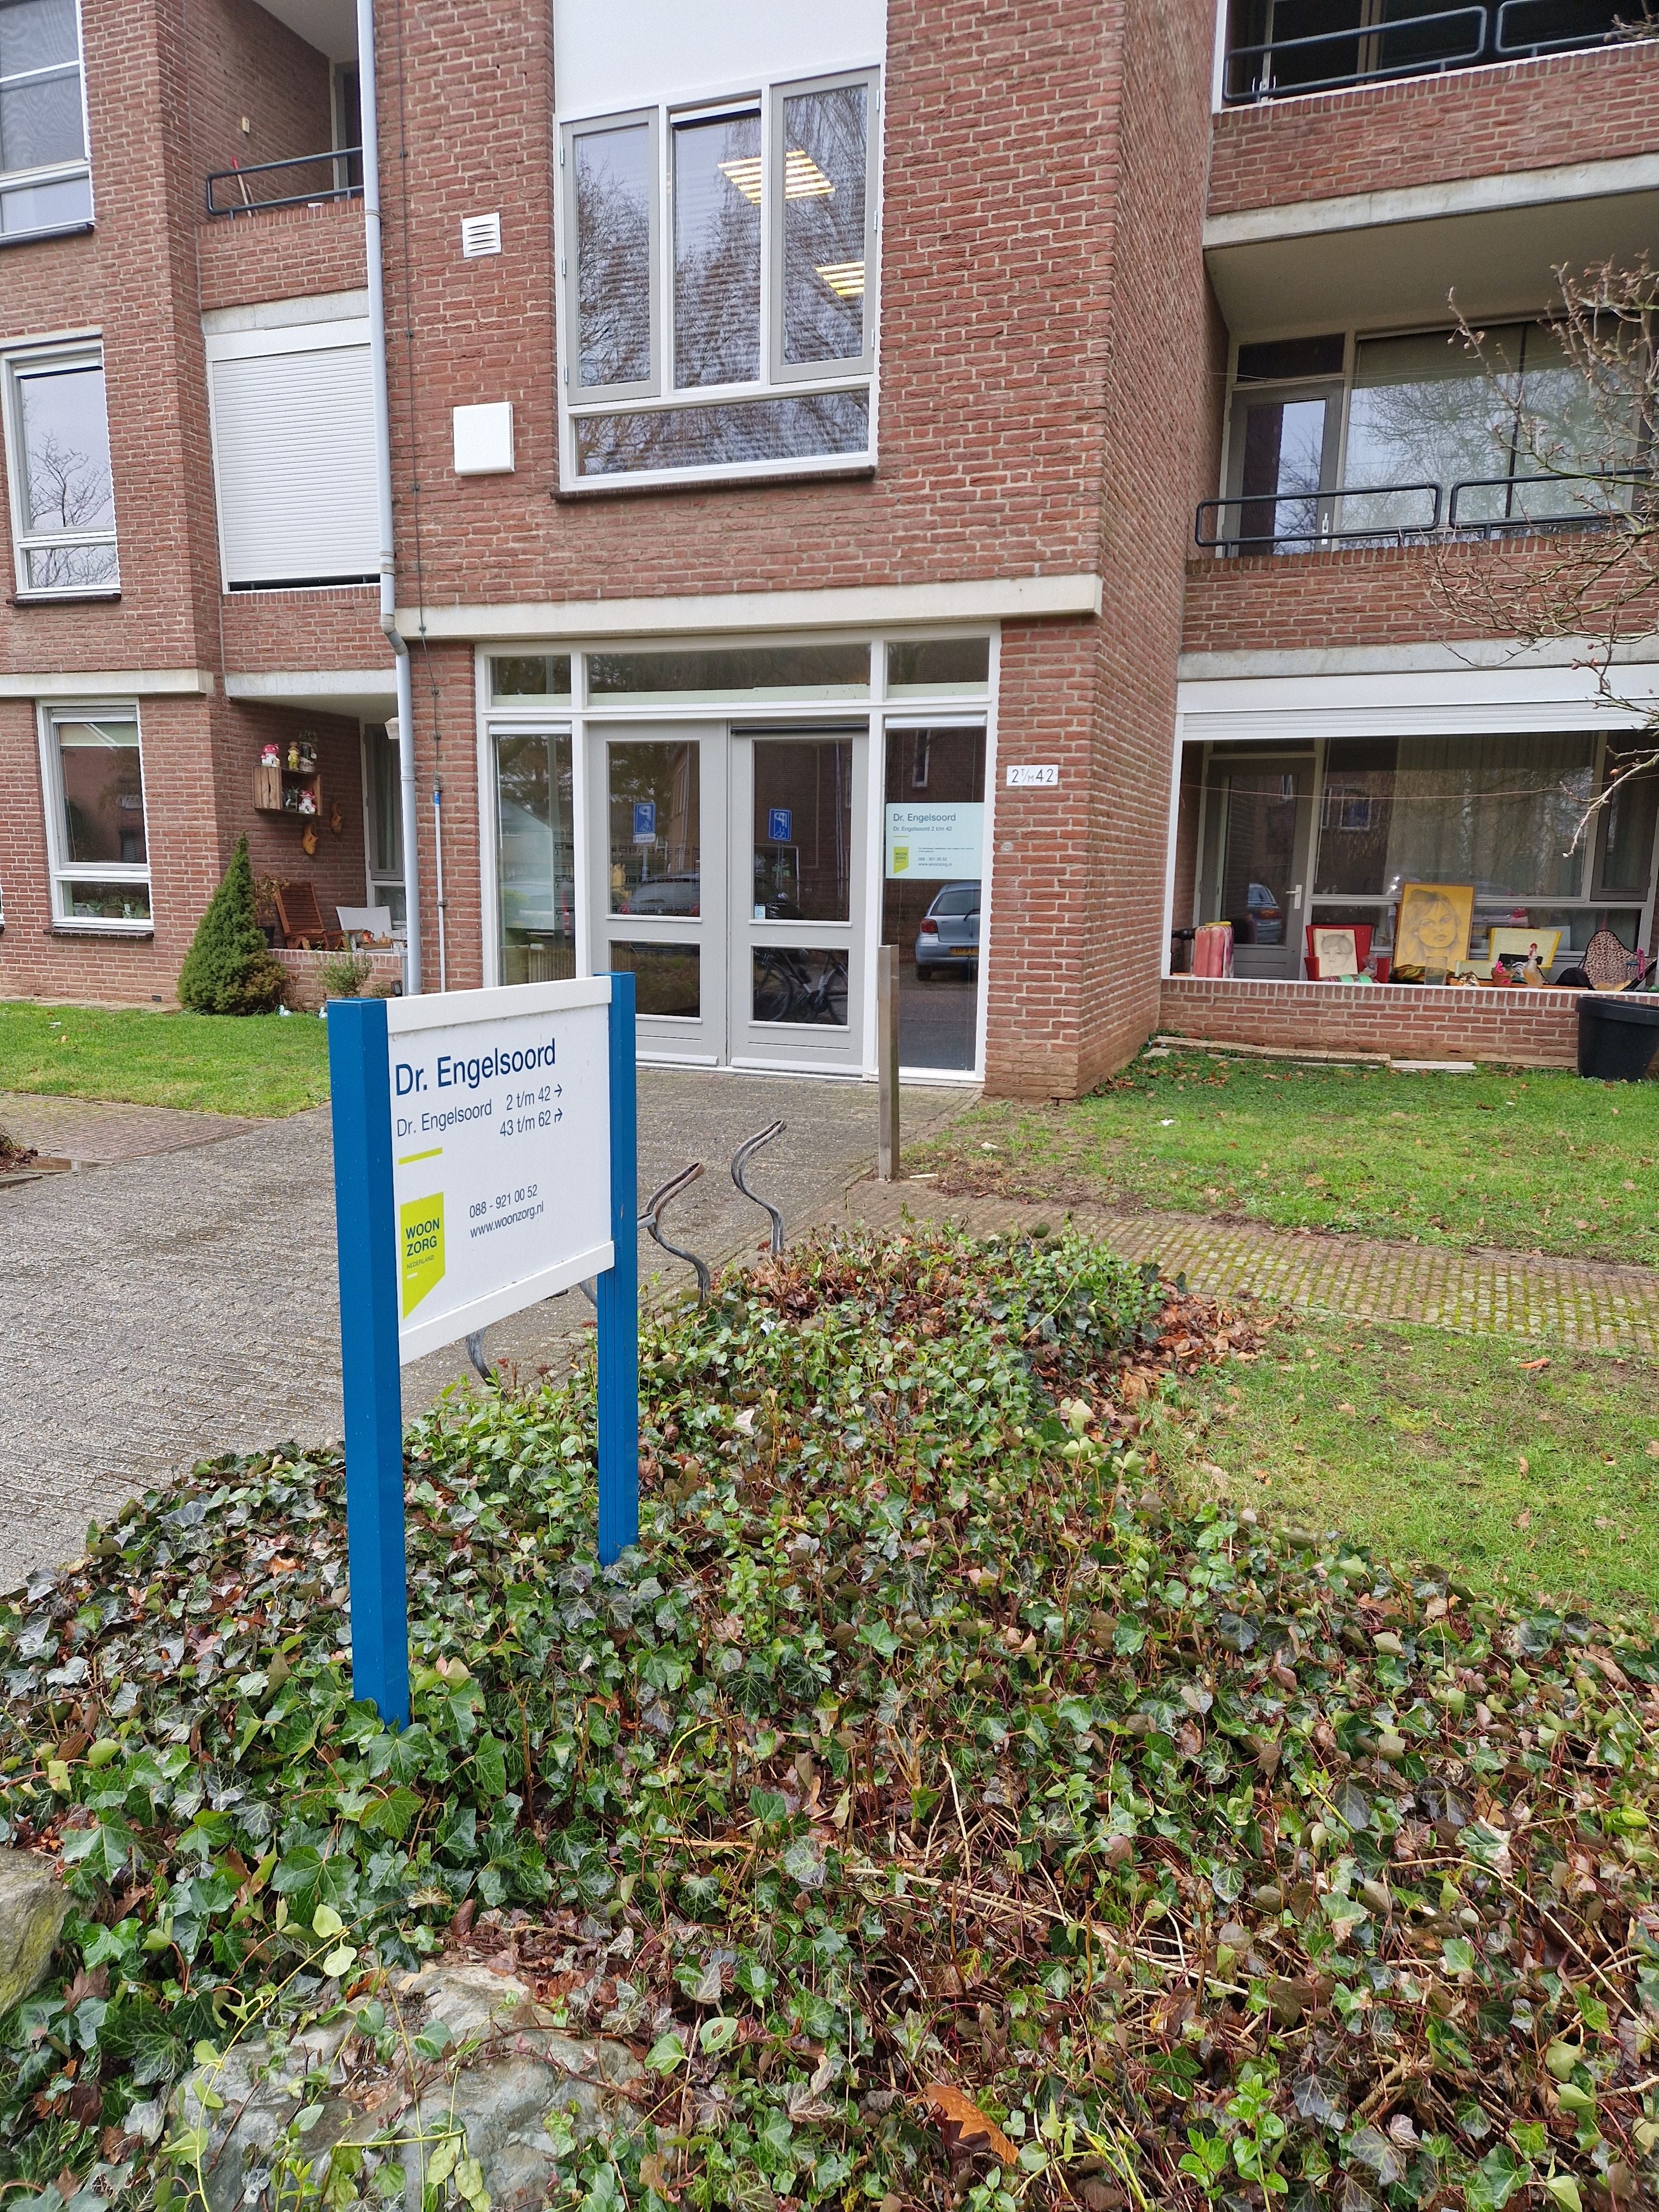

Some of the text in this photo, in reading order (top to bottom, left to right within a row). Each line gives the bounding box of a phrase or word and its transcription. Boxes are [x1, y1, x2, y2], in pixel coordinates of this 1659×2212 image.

[893, 813, 956, 823] Dr. Engelsoord
[395, 1037, 556, 1096] Dr. Engelsoord
[397, 1085, 551, 1137] Dr. Engelsoord 2 t/m 42
[499, 1109, 551, 1137] 43 t/m 62
[469, 1201, 487, 1218] 088
[495, 1192, 511, 1209] 921
[514, 1188, 525, 1203] 00
[527, 1184, 538, 1198] 52
[406, 1217, 440, 1240] WOON
[470, 1200, 544, 1239] www.woonzorg.nl
[406, 1235, 437, 1258] ZORG
[406, 1255, 434, 1270] NEDERLAND
